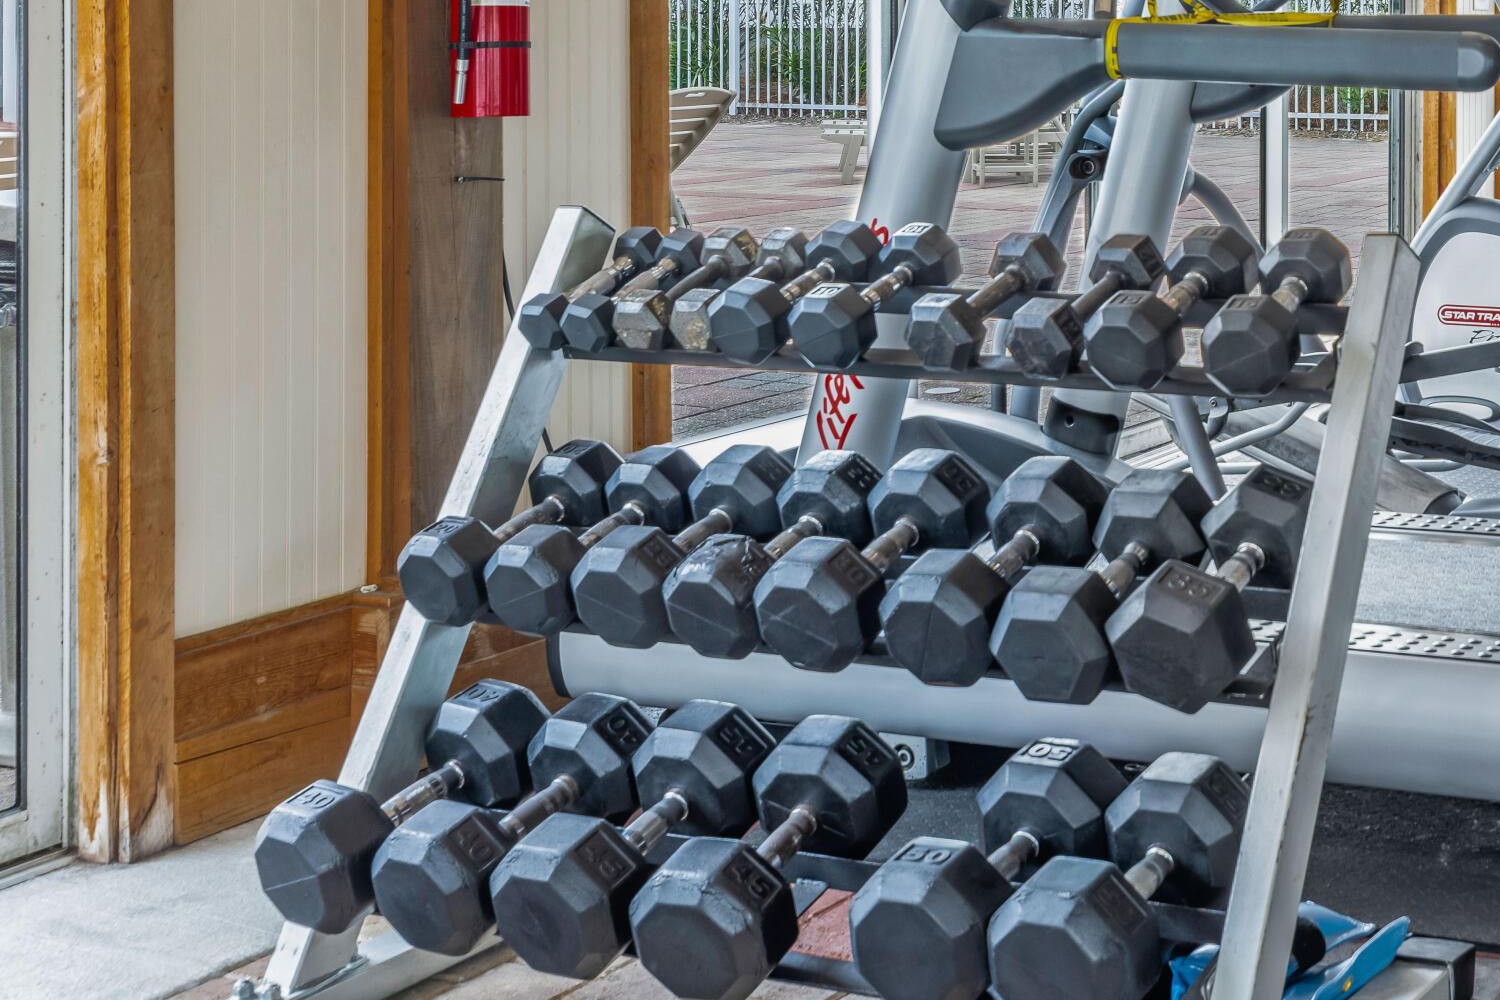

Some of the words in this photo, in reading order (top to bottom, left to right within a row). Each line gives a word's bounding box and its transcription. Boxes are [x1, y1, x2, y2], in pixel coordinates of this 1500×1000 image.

[1443, 310, 1475, 321] STAR
[1028, 742, 1073, 761] 50
[300, 791, 335, 809] 40
[906, 847, 952, 866] 50
